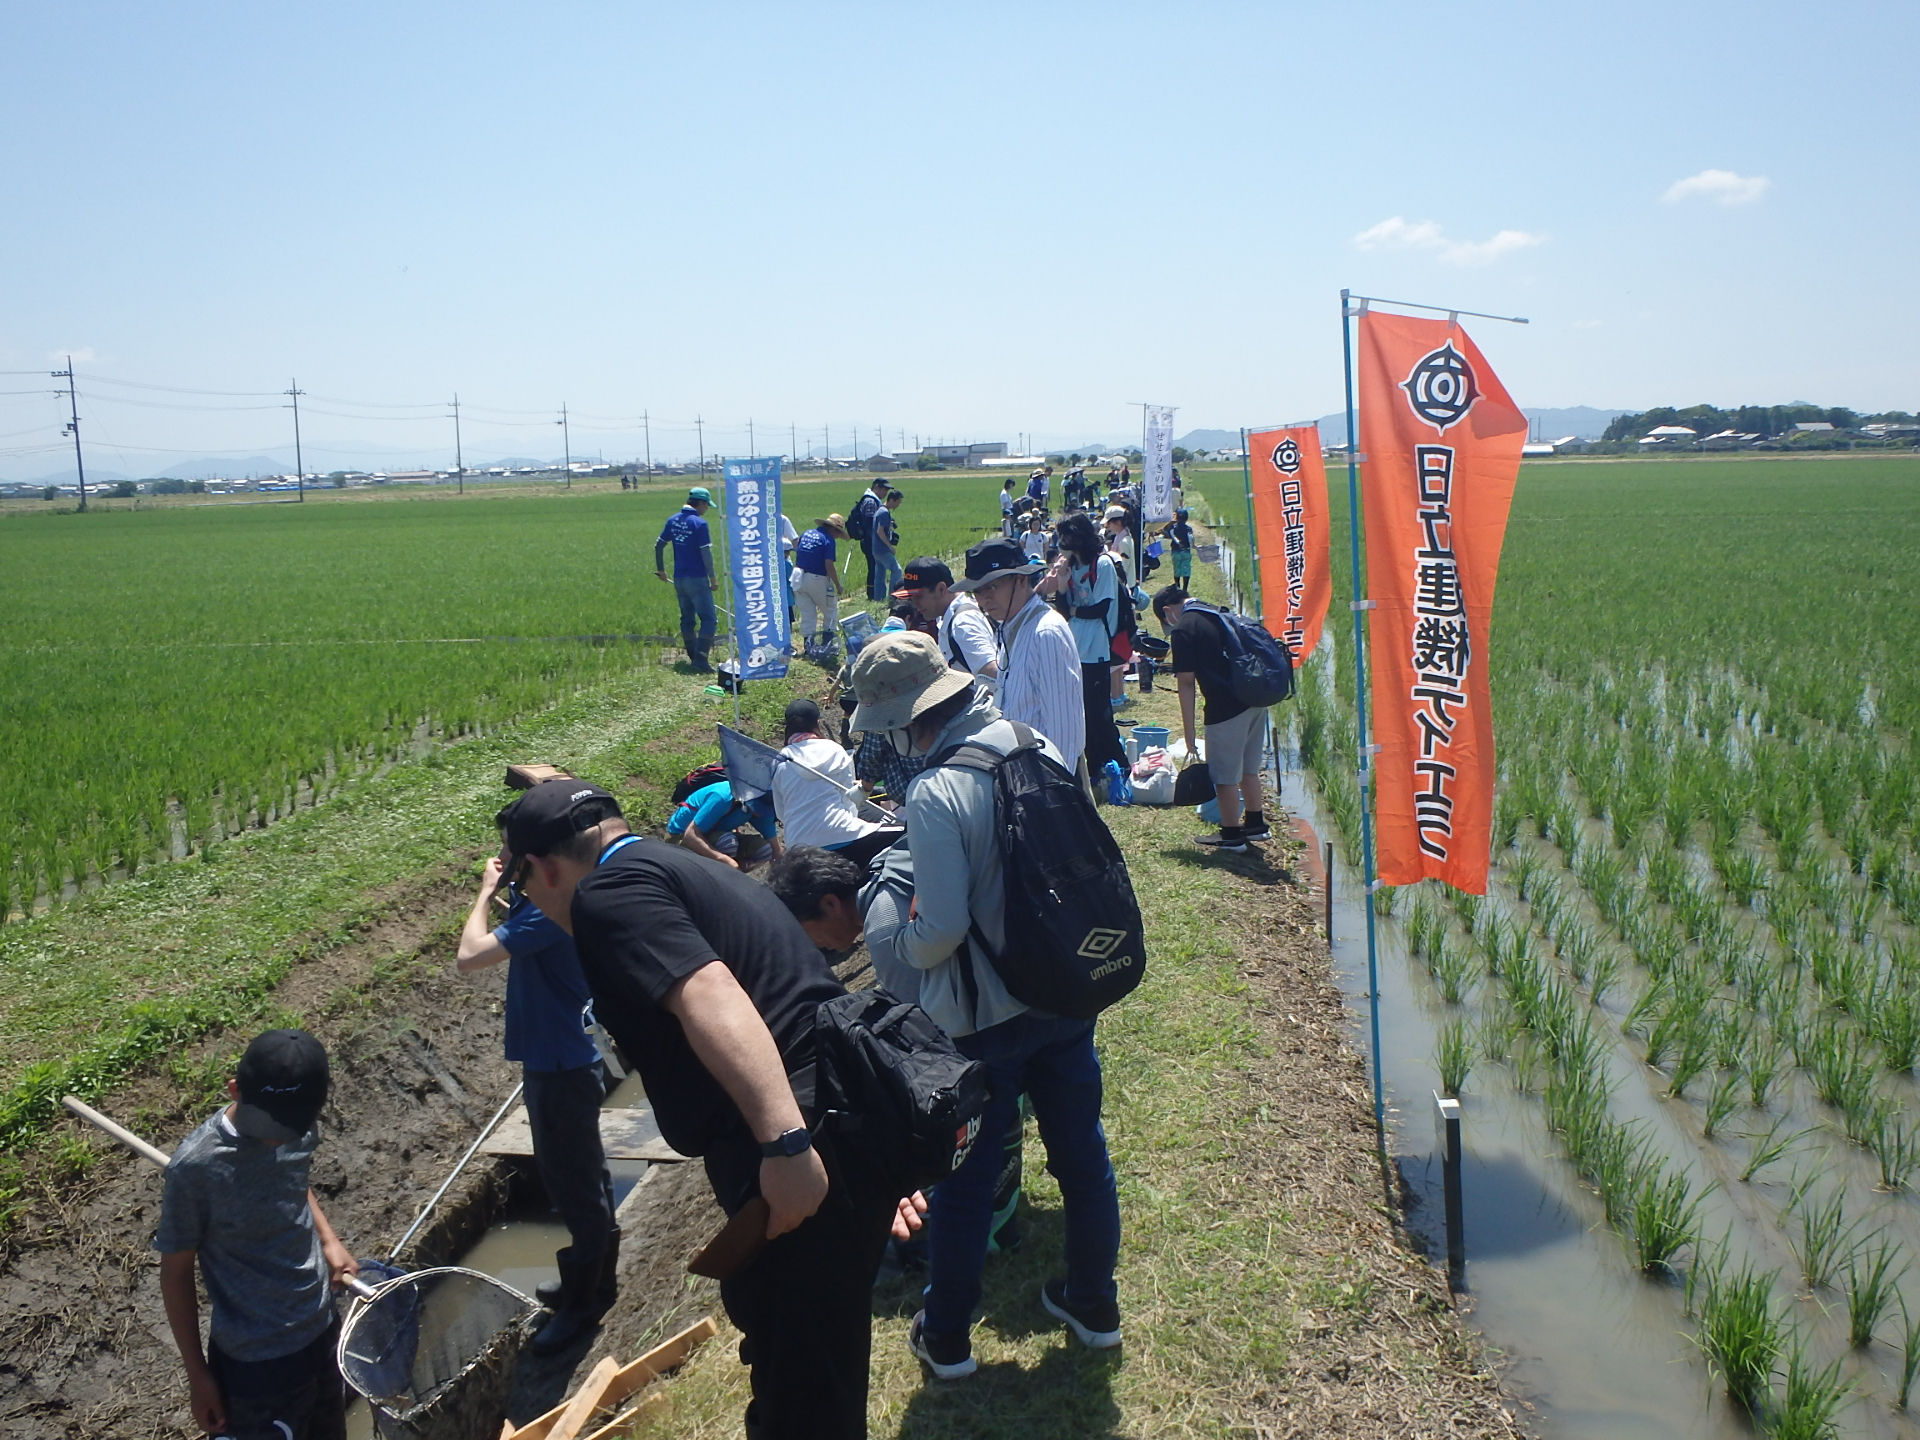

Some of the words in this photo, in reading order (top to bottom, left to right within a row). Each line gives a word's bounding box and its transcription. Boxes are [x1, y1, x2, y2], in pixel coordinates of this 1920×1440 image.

[729, 463, 763, 476] 滋賀県
[736, 480, 769, 645] 魚のゆりかご水田プロジェクト
[1090, 955, 1133, 981] umbro
